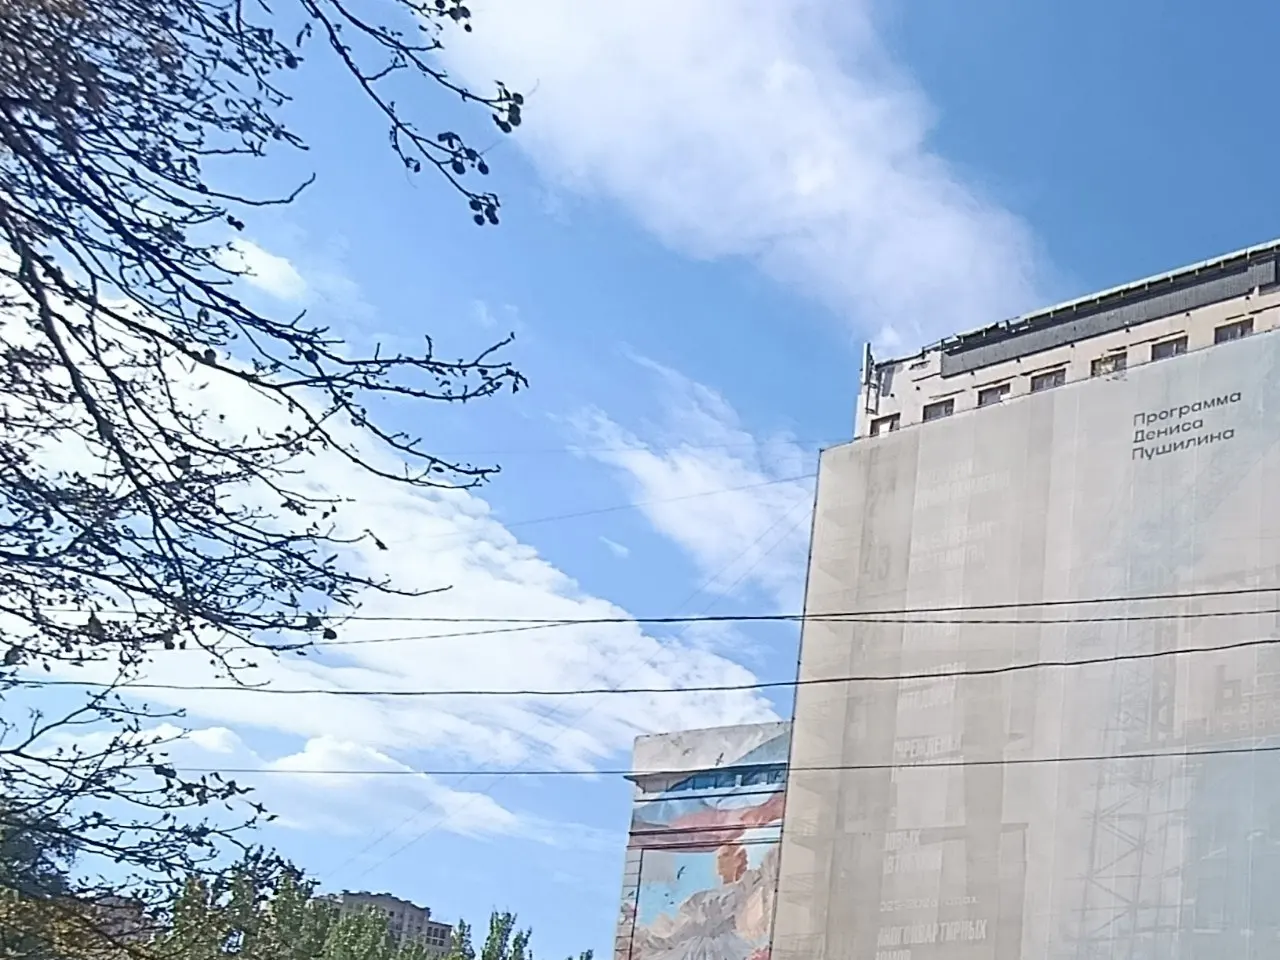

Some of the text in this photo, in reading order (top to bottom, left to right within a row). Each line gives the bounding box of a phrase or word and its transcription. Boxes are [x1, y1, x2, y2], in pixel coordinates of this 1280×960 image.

[1133, 392, 1241, 426] Программа
[1132, 429, 1235, 460] Пушилина
[1133, 419, 1204, 444] Дениса
